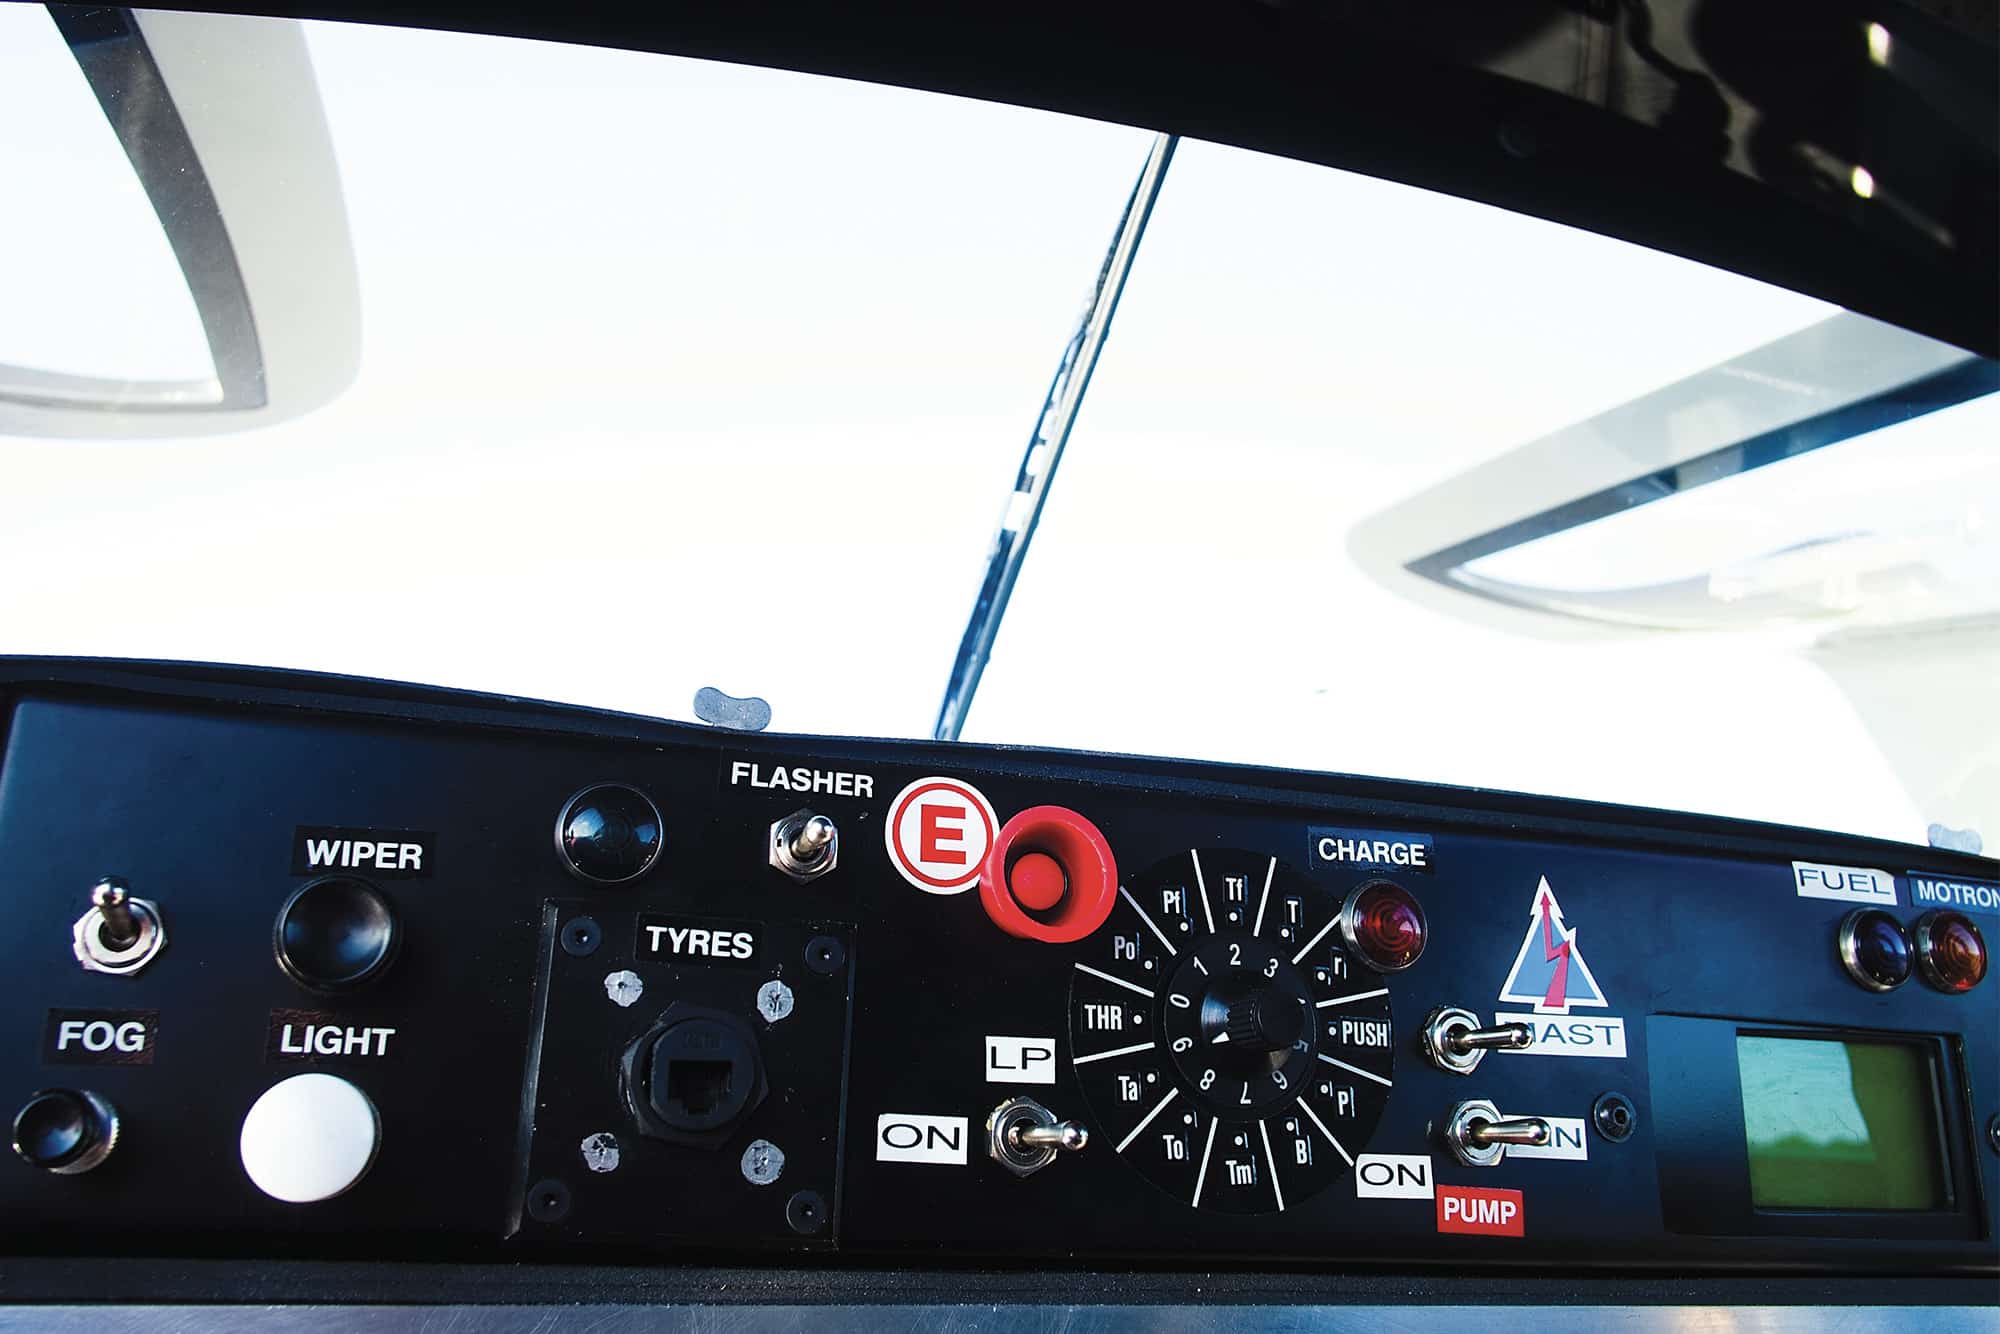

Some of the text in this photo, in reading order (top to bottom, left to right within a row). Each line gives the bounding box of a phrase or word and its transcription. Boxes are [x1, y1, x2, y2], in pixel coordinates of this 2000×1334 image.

[731, 761, 874, 798] FLASHER
[920, 804, 967, 864] E
[306, 839, 423, 870] WIPER
[1318, 837, 1425, 867] CHARGE
[1226, 877, 1243, 900] Tf
[1799, 868, 1892, 896] FUEL
[1163, 890, 1181, 914] Pf
[646, 925, 753, 959] TYRES
[1114, 935, 1135, 960] Po
[1229, 943, 1240, 965] 2
[1264, 958, 1279, 978] 3
[1084, 1004, 1122, 1030] THR
[57, 1020, 144, 1052] FOG
[280, 1023, 395, 1056] LIGHT
[1342, 1020, 1387, 1047] PUSH
[1505, 1022, 1620, 1046] AST
[990, 1046, 1051, 1070] LP
[1118, 1075, 1137, 1101] Ta
[1200, 1069, 1215, 1090] 8
[1240, 1081, 1252, 1104] 7
[1338, 1090, 1349, 1115] P
[882, 1122, 961, 1151] ON
[1163, 1134, 1183, 1160] To
[1296, 1137, 1307, 1163] B
[1226, 1160, 1253, 1186] Tm
[1360, 1163, 1427, 1187] ON
[1444, 1197, 1517, 1225] PUMP
